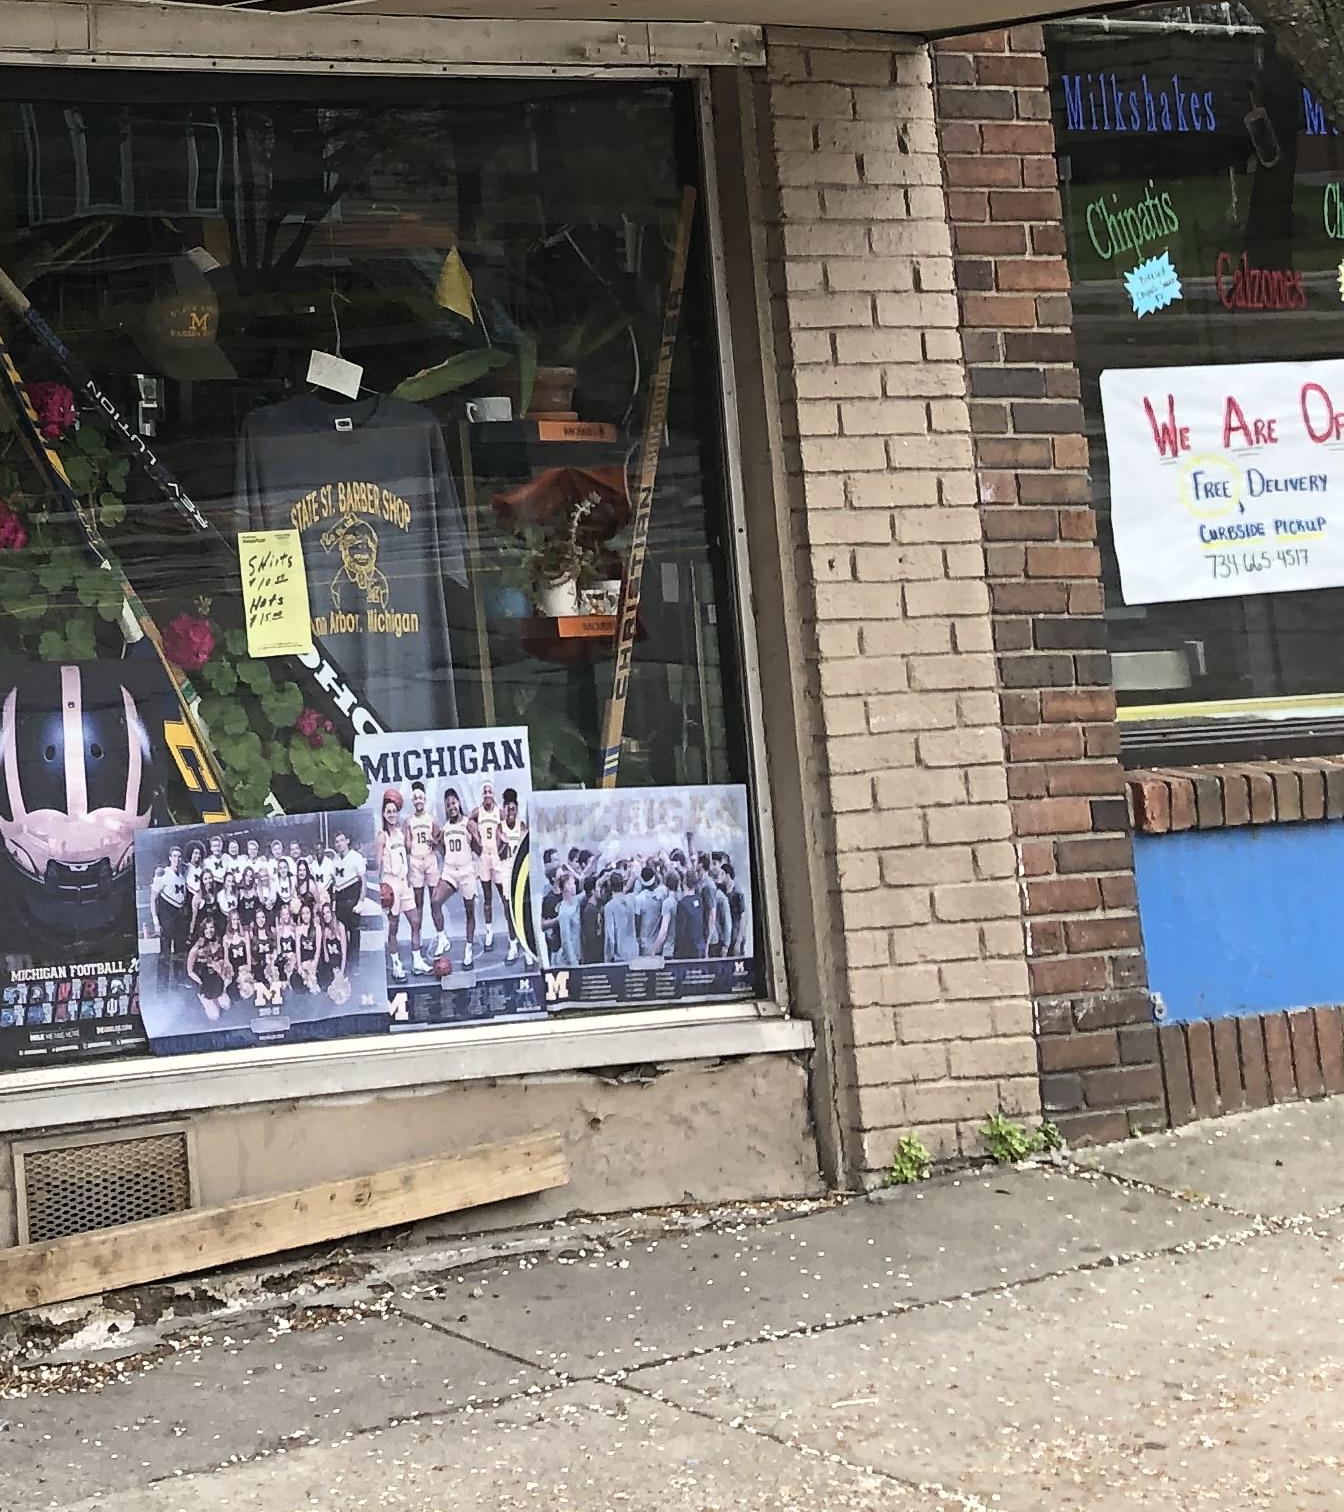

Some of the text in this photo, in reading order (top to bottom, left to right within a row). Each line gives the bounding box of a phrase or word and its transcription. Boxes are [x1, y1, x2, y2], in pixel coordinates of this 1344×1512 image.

[1062, 73, 1216, 132] Milkshakes
[1086, 179, 1178, 264] Chipatis
[1216, 251, 1308, 310] Calzones
[86, 379, 210, 529] REVLUTION
[291, 490, 320, 532] STATE
[338, 481, 381, 517] BARBER
[382, 489, 411, 532] SHOP
[367, 609, 419, 638] Michigan
[360, 738, 525, 785] MICHIGAN
[11, 965, 67, 982] MICHIGAN
[70, 961, 126, 978] FOOTBALL
[254, 980, 284, 1007] M
[544, 971, 571, 1001] M
